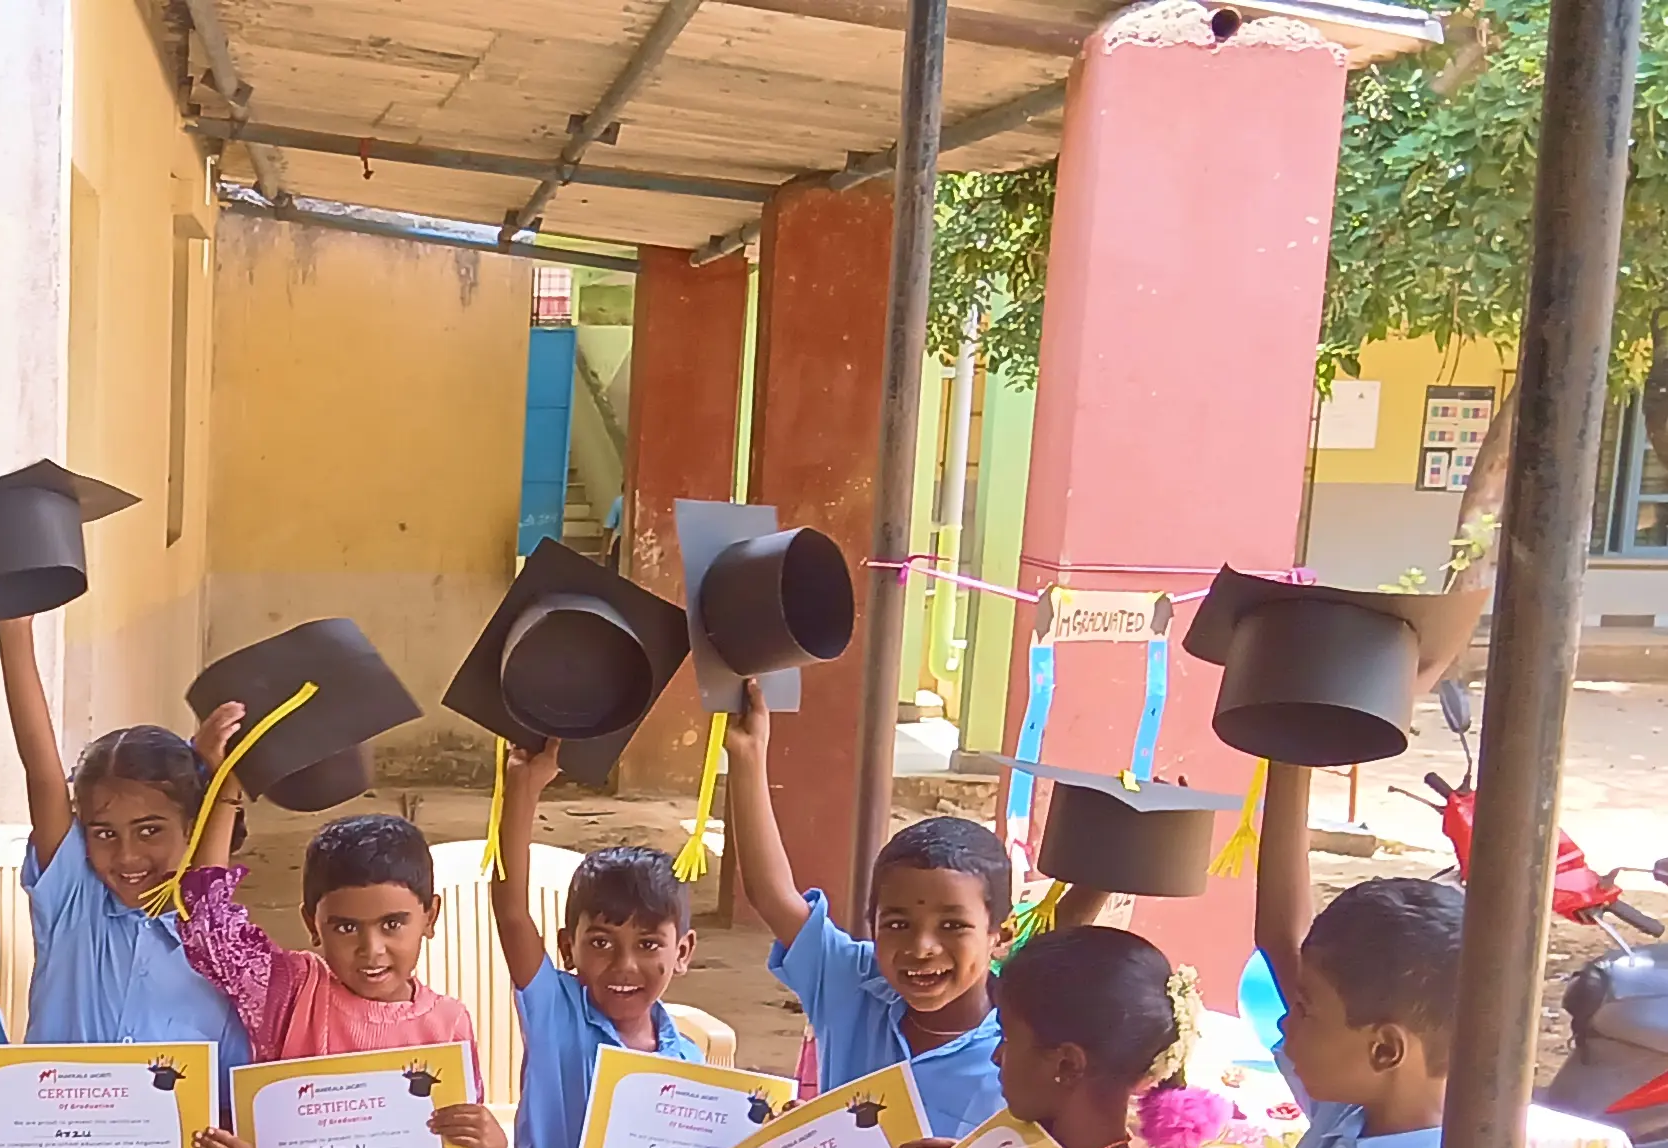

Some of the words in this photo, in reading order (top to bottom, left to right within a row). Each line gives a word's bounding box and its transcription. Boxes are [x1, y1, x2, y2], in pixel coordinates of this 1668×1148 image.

[37, 1087, 128, 1098] CERTIFICATE
[297, 1096, 385, 1115] CERTIFICATE
[655, 1102, 728, 1124] CERTIFICATE
[317, 1118, 327, 1127] Of
[328, 1115, 372, 1124] Graduation
